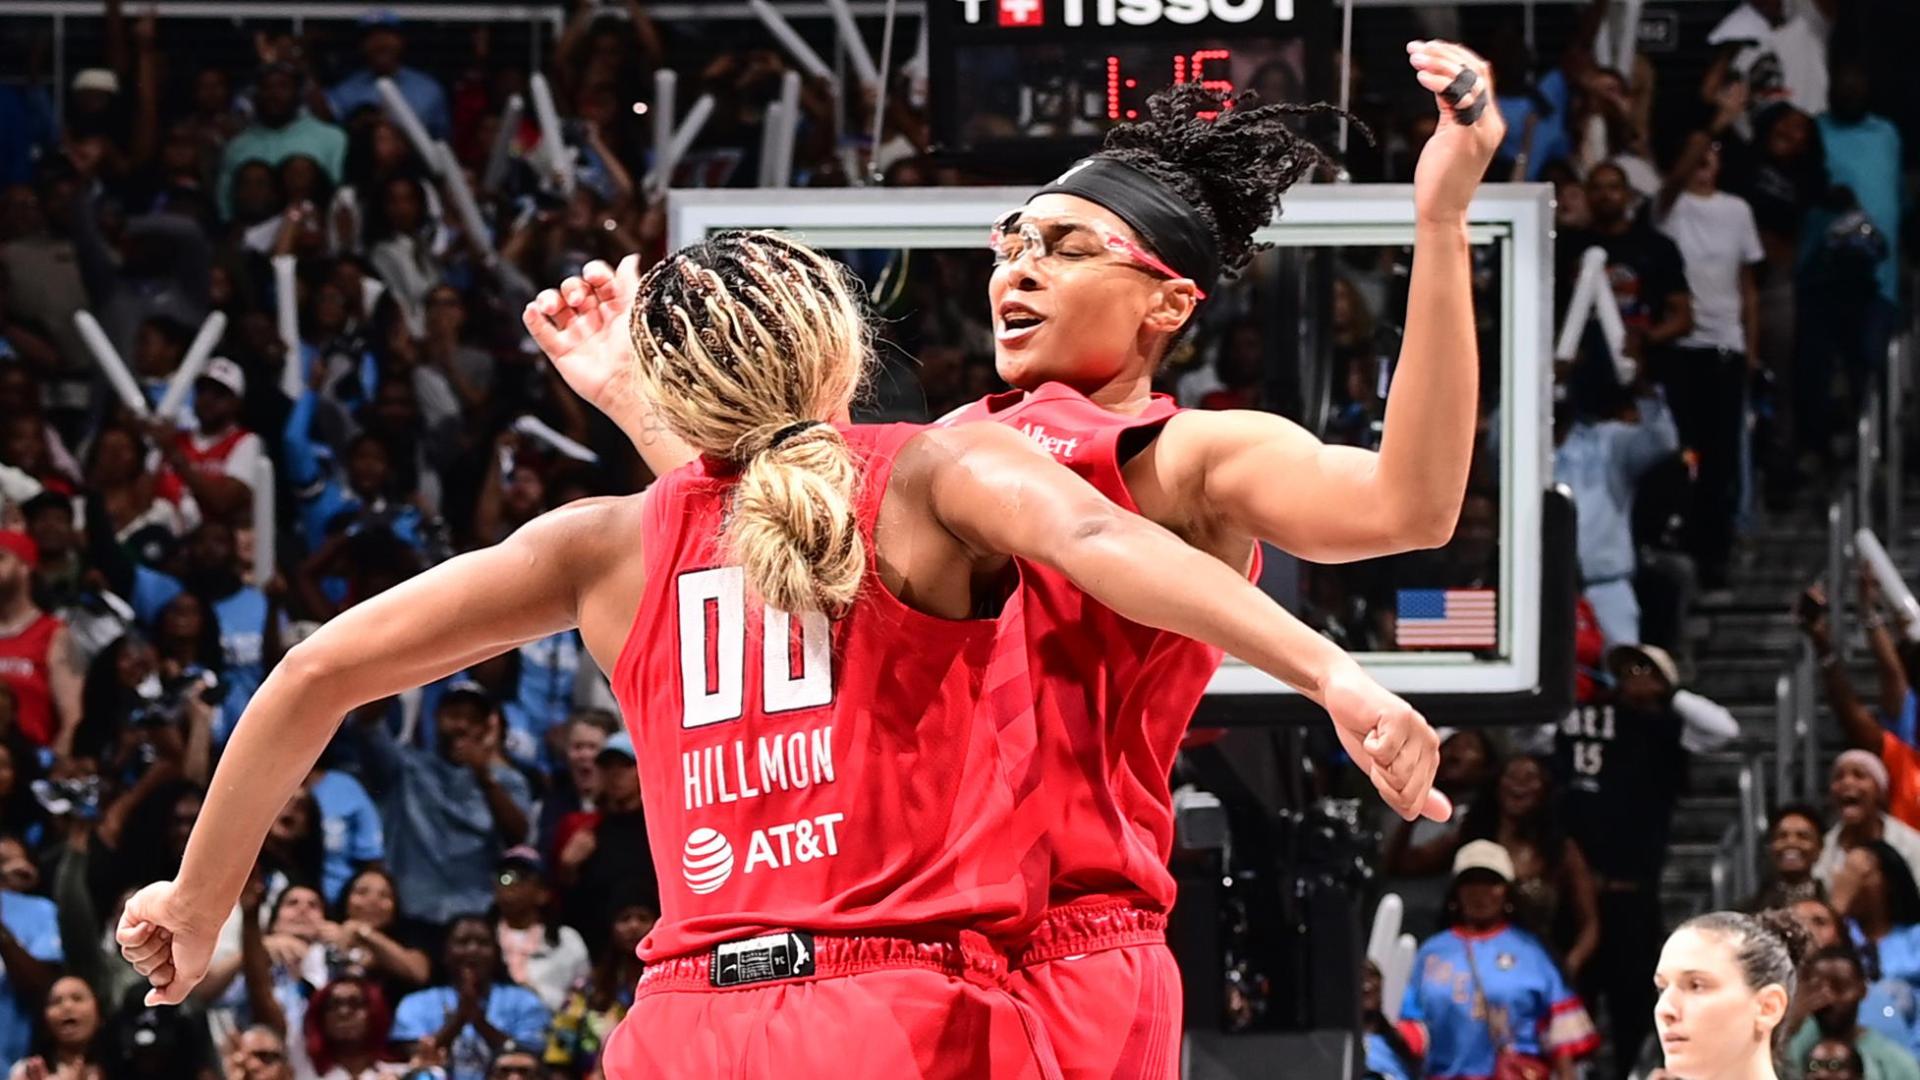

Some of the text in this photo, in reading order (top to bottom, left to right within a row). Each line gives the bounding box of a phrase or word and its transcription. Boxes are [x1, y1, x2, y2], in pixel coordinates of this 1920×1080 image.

[1021, 421, 1078, 458] Albert
[677, 565, 833, 729] 00
[682, 726, 835, 810] HILLMON
[743, 812, 845, 874] AT&T
